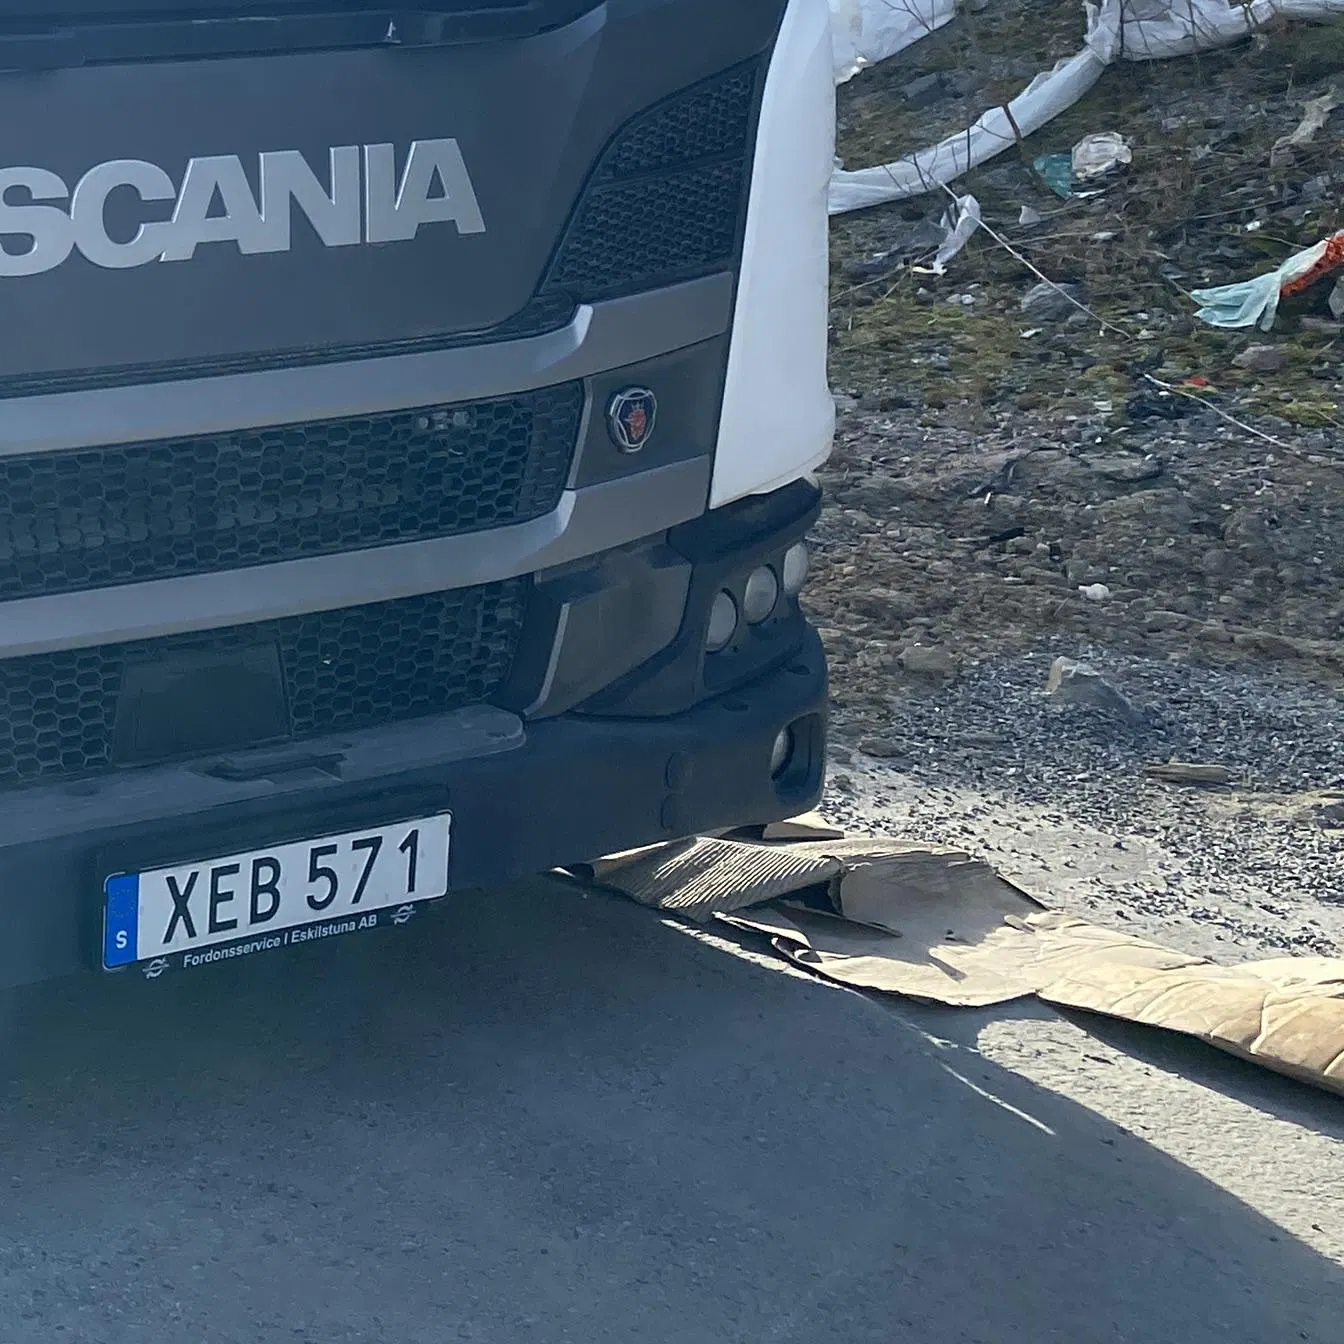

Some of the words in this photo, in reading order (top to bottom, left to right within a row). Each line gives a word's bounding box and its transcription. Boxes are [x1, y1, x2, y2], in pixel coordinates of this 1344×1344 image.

[162, 856, 282, 945] XEB
[305, 828, 420, 912] 571
[115, 929, 128, 950] S
[183, 935, 281, 967] Fordonsservice
[291, 920, 356, 944] Eskilstuna
[358, 914, 378, 930] AB
